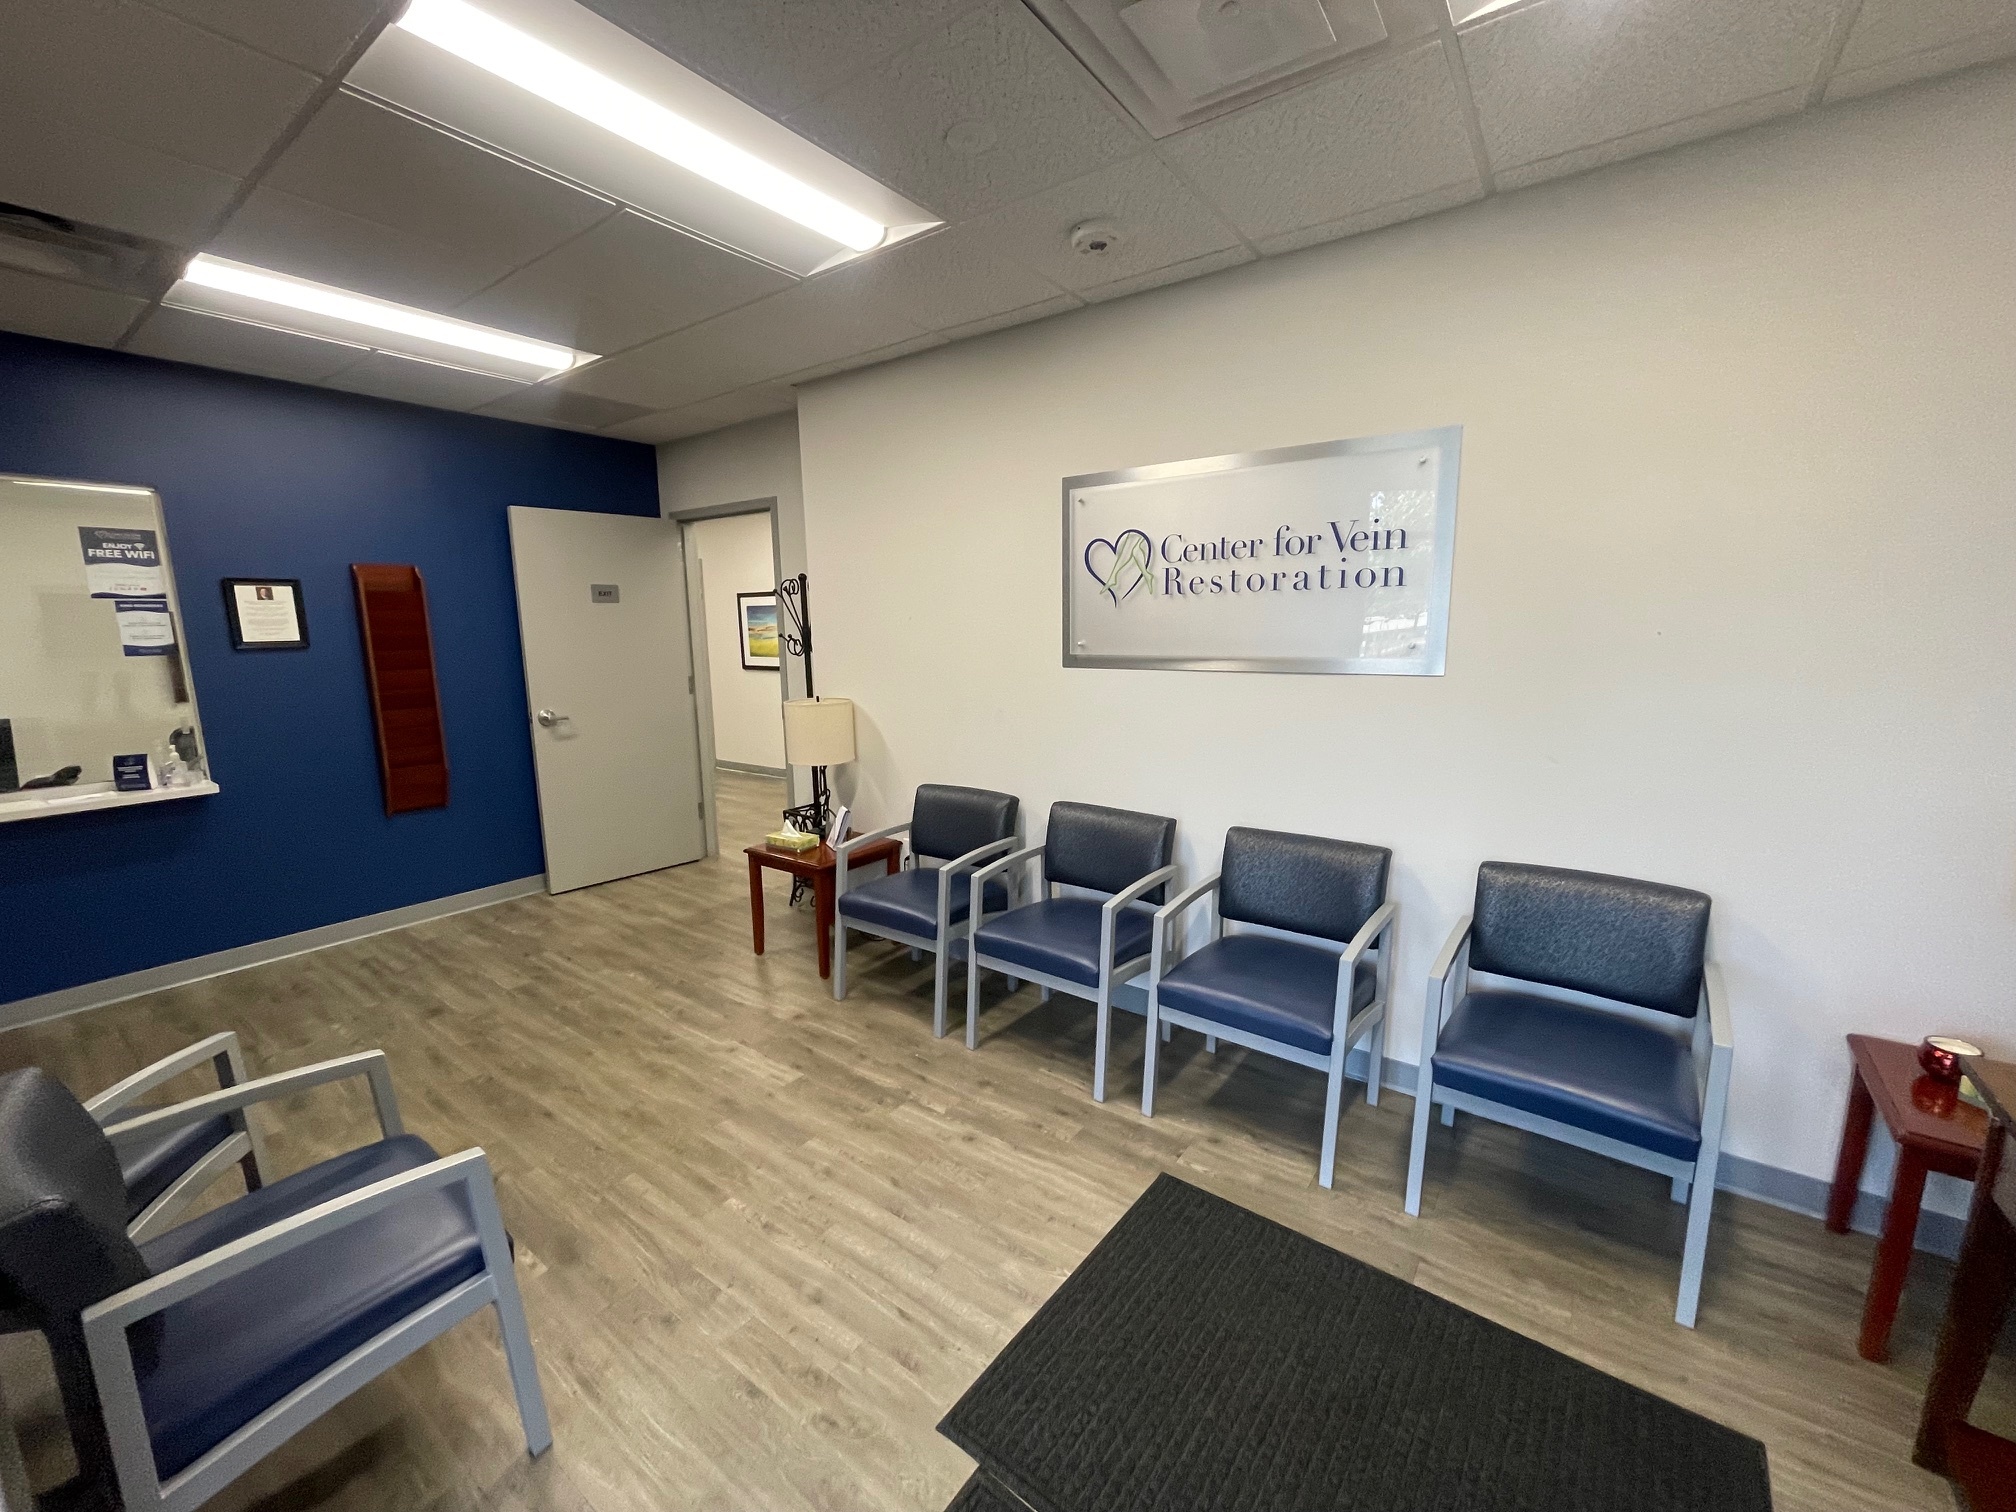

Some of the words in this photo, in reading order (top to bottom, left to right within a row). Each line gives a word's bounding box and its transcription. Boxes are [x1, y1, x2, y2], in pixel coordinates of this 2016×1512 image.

[102, 542, 132, 550] ENJOY
[1161, 533, 1264, 564] Center
[1272, 525, 1322, 557] for
[1327, 518, 1408, 554] Vein
[87, 548, 123, 559] FREE
[124, 550, 155, 560] WIFI
[1161, 557, 1407, 596] Restoration
